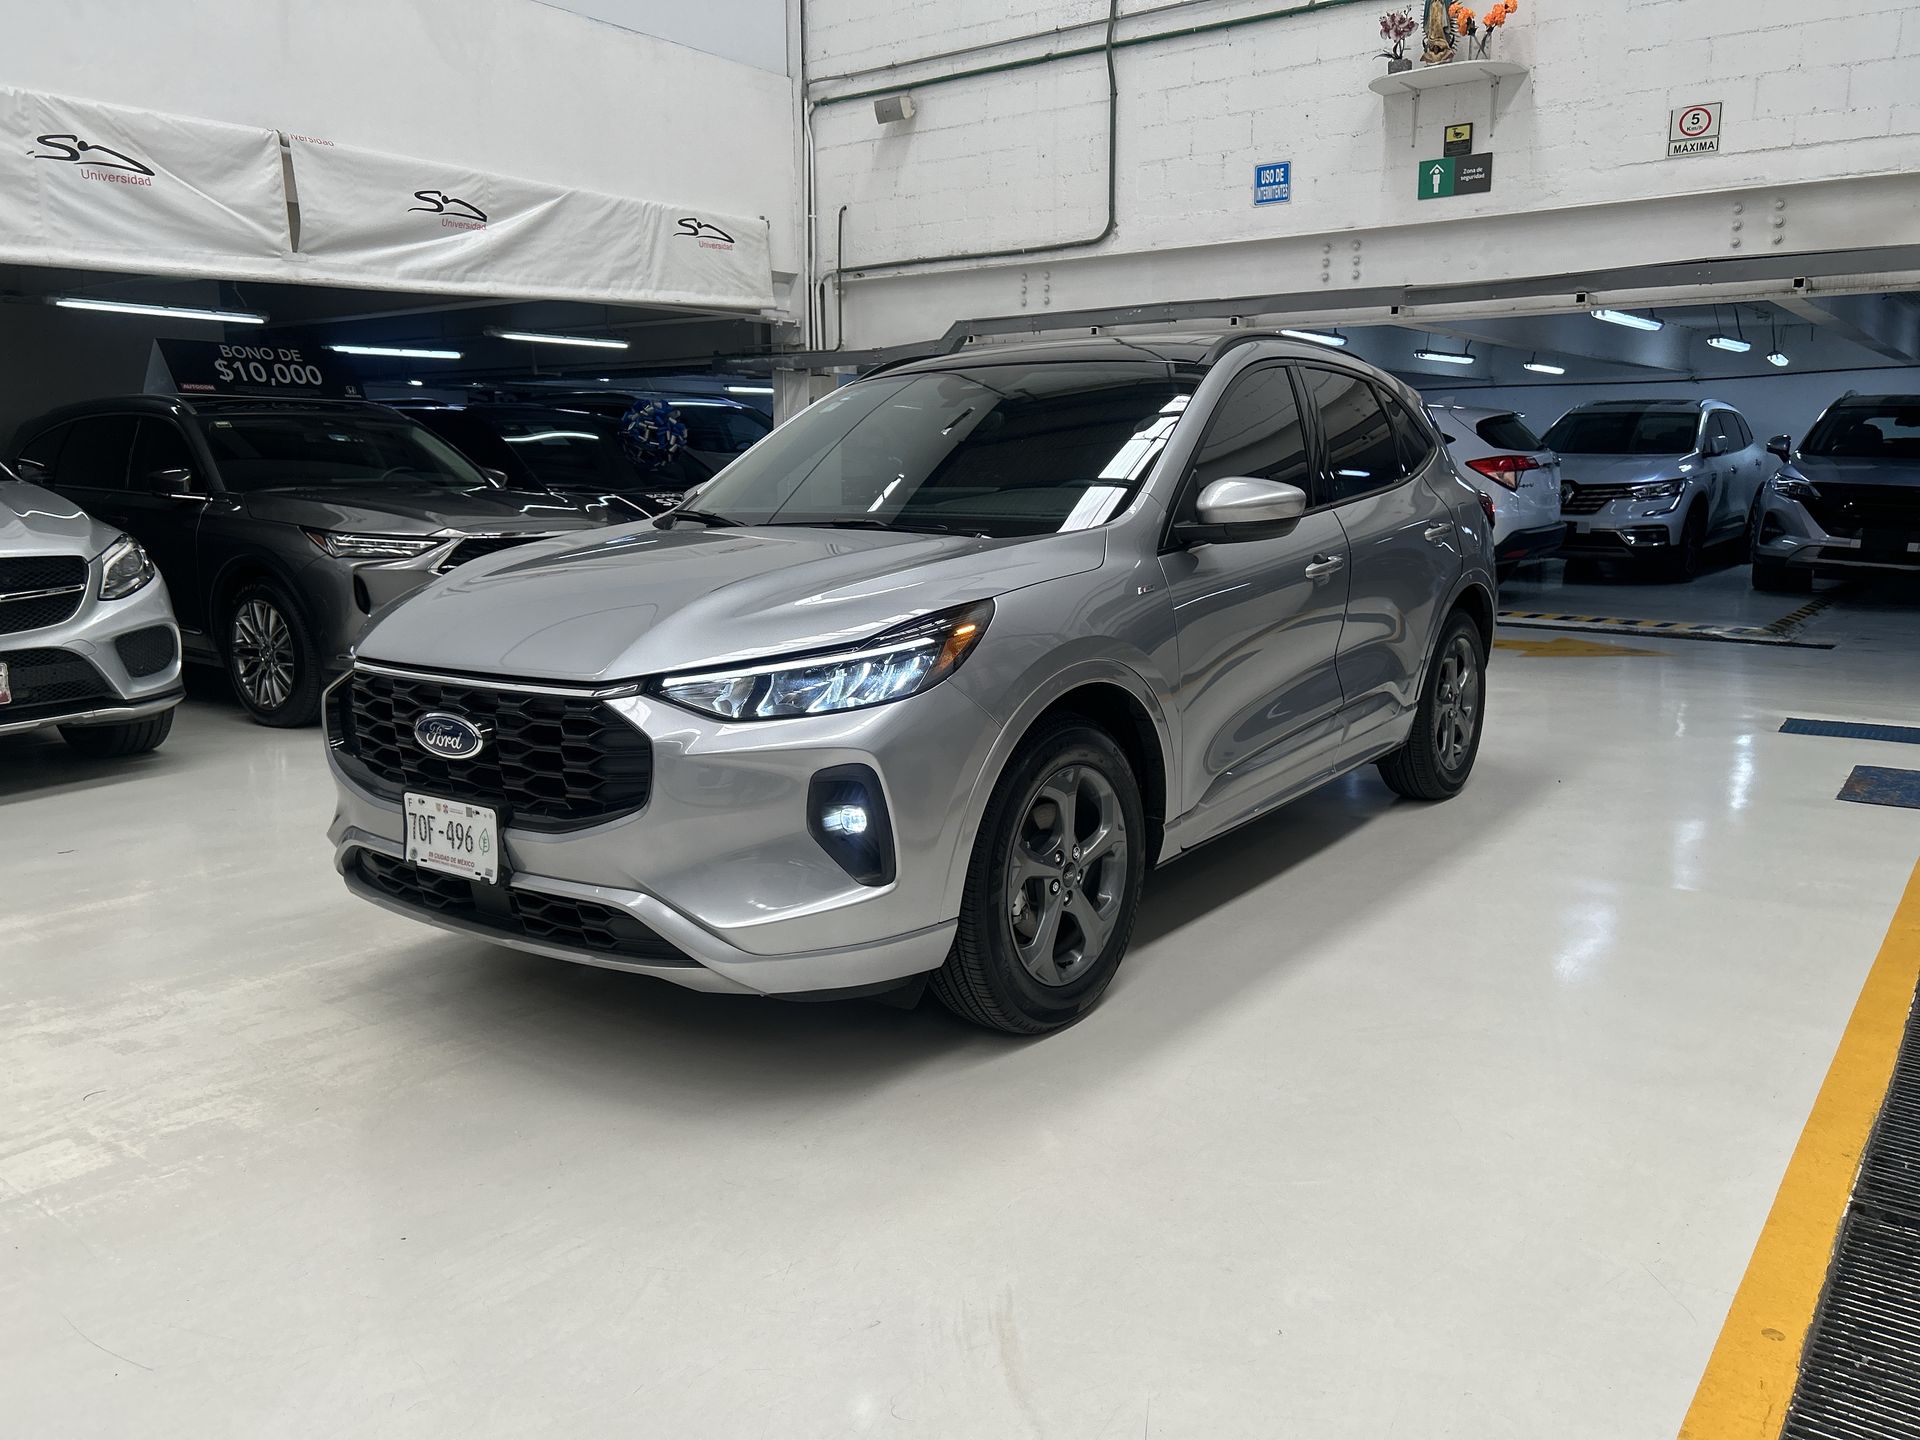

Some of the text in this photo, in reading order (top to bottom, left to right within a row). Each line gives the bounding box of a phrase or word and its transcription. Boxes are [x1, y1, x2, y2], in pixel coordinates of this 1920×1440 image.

[1691, 113, 1700, 125] 5
[80, 168, 152, 186] Universidad
[1260, 167, 1285, 185] USO DE
[1460, 173, 1485, 182] seguridad
[441, 218, 487, 231] Universidad
[219, 344, 303, 362] BONO DE
[214, 358, 323, 387] $10,000
[426, 721, 463, 750] Ford
[408, 812, 474, 853] 70F-496
[434, 852, 450, 862] CIUDAD
